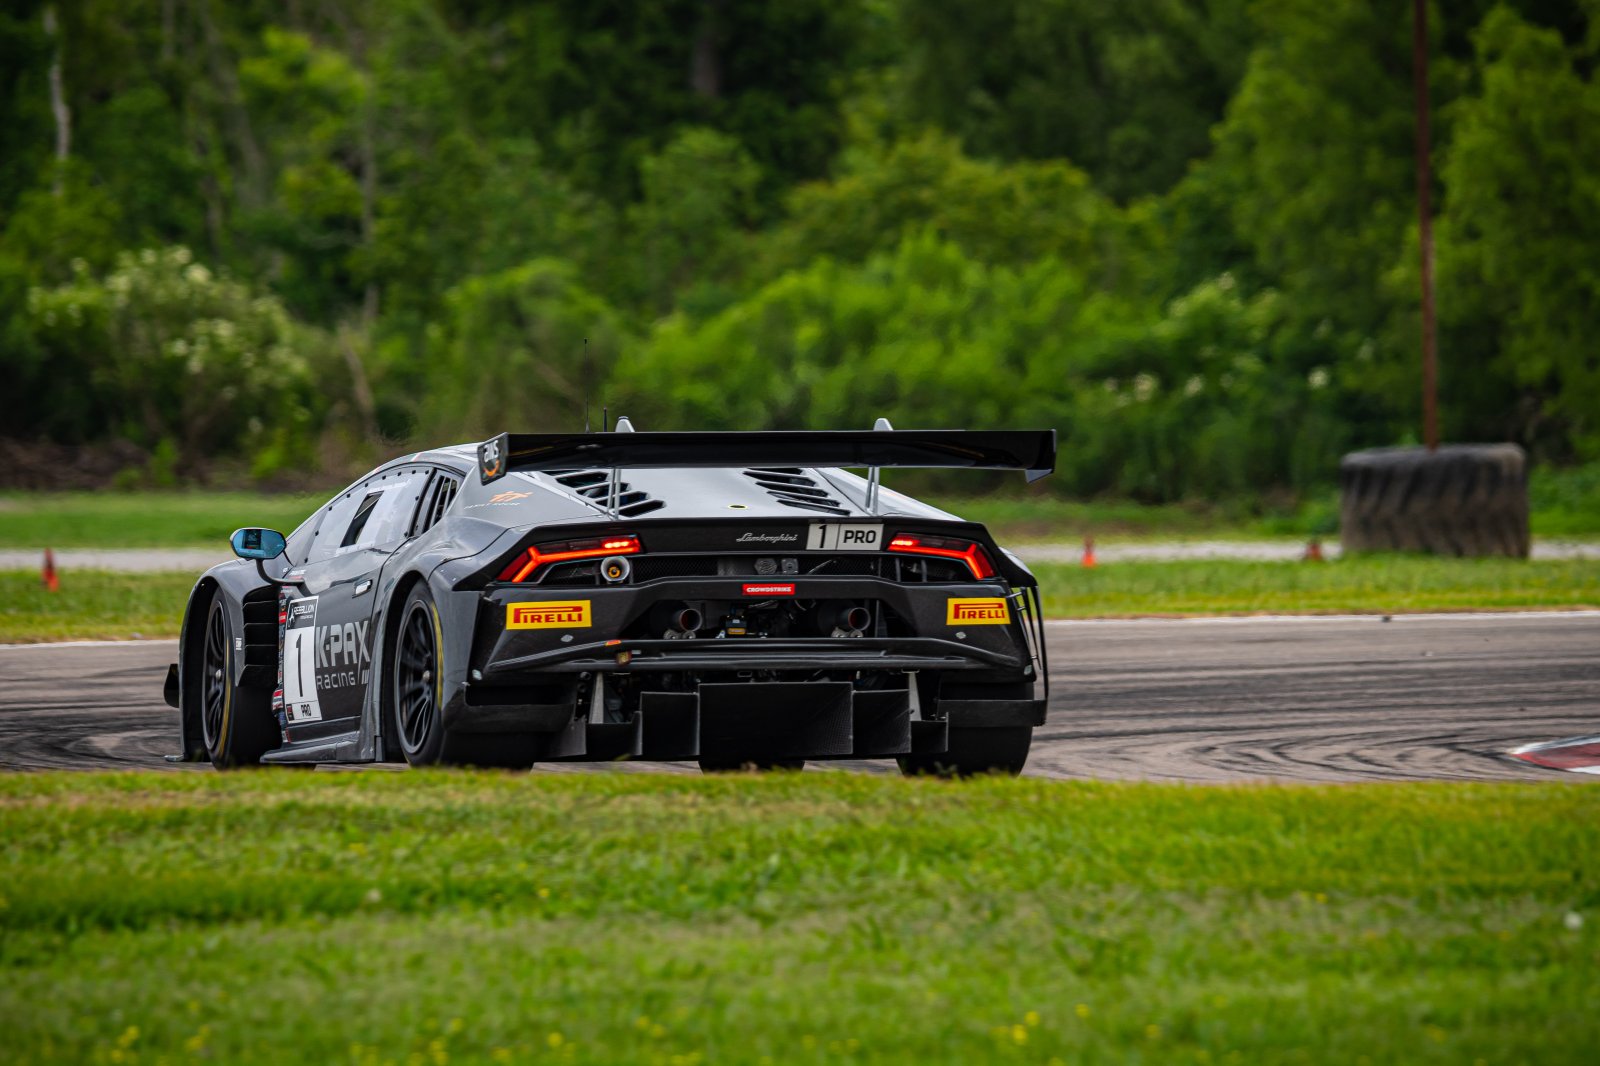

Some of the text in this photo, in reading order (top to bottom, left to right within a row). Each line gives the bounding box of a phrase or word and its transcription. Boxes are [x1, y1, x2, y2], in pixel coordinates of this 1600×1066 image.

[736, 533, 798, 543] Lamborghini
[819, 524, 877, 549] 1 PRO
[513, 606, 583, 624] PIRELLI
[953, 602, 1005, 619] PIRELLI
[315, 620, 371, 669] K-PAX
[295, 633, 304, 697] 1
[301, 704, 311, 717] PRO
